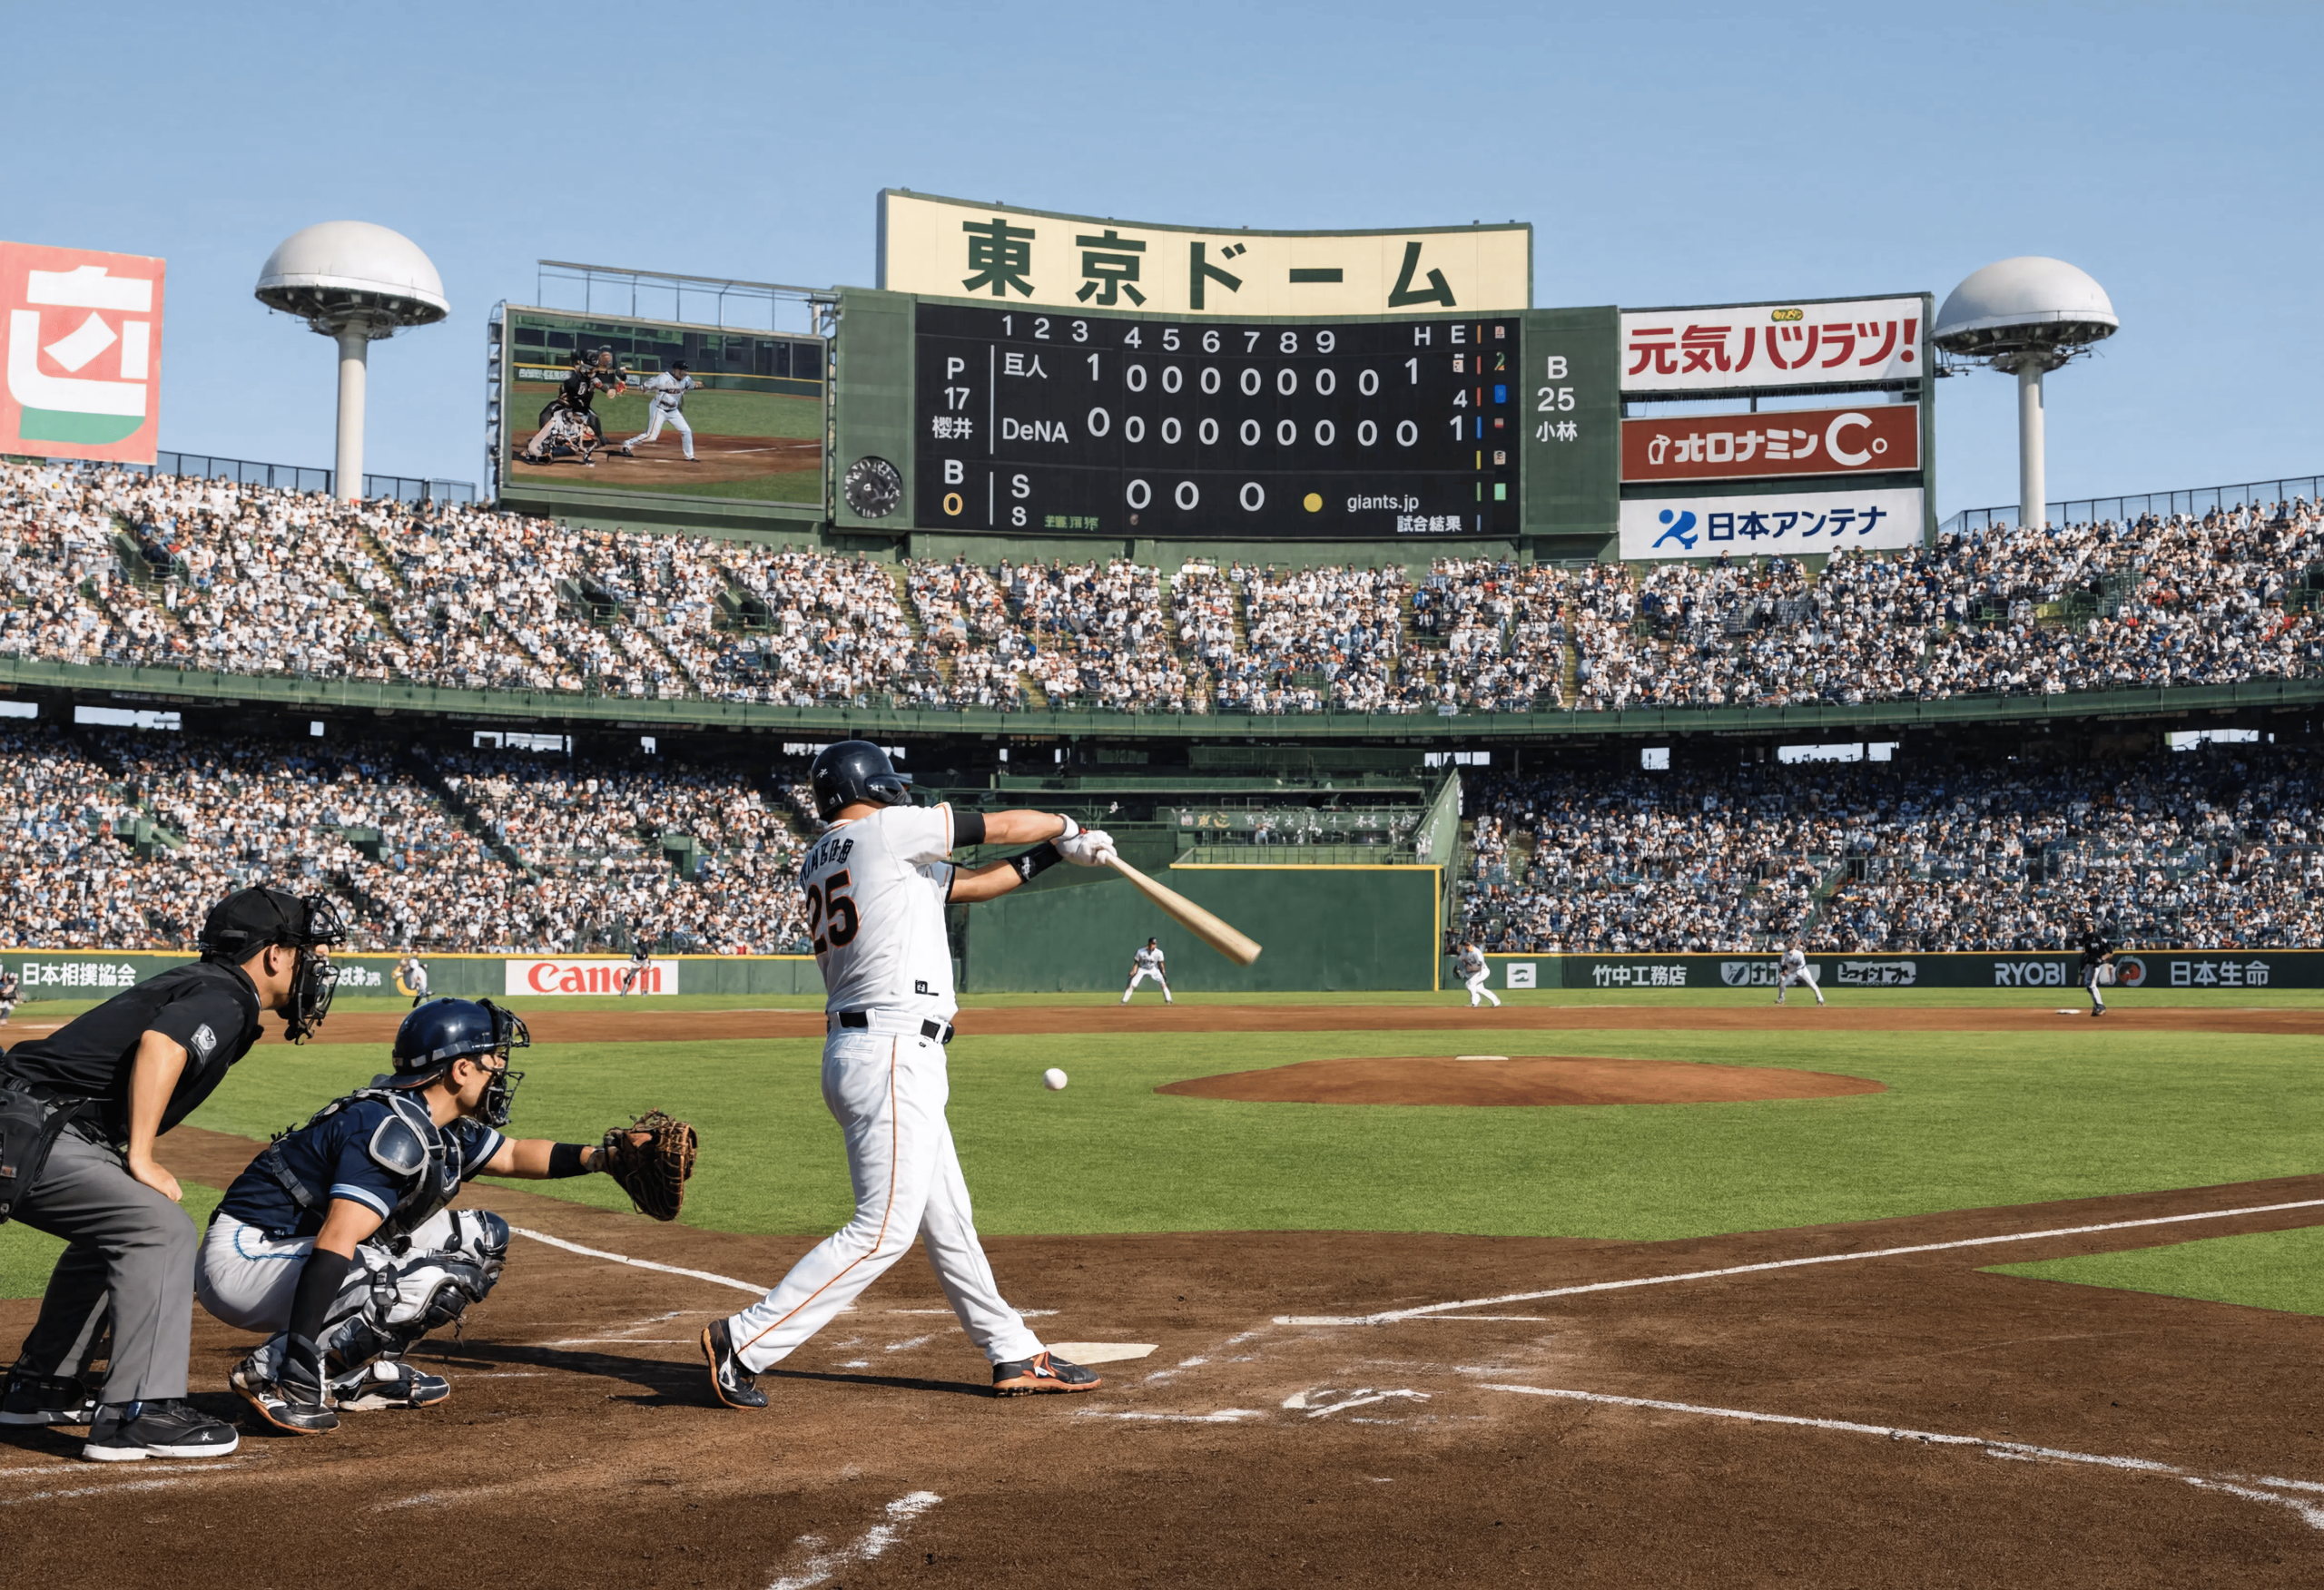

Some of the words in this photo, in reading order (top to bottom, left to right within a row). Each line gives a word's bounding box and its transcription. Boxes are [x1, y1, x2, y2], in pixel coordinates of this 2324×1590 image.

[962, 219, 1457, 309] 東京ドーム
[1002, 315, 1012, 336] 1
[1034, 318, 1050, 339] 2
[1071, 320, 1088, 342] 3
[1124, 327, 1142, 348] 4
[1162, 329, 1180, 351] 5
[1202, 330, 1221, 353] 6
[1244, 331, 1260, 353] 7
[1279, 331, 1298, 353] 8
[1315, 330, 1335, 353] 9
[1414, 327, 1431, 346] H
[1451, 325, 1466, 344] E
[947, 357, 965, 380] P
[1003, 352, 1049, 379] 巨人
[1087, 353, 1099, 381] 1
[1126, 364, 1147, 392] 0
[1161, 366, 1183, 394] 0
[1200, 367, 1221, 395] 0
[1240, 368, 1262, 396] 0
[1276, 368, 1297, 396] 0
[1316, 368, 1336, 396] 0
[1358, 368, 1379, 396] 0
[1404, 358, 1418, 385] 1
[1547, 355, 1569, 379] B
[944, 387, 970, 410] 17
[1452, 389, 1468, 408] 4
[1537, 387, 1575, 411] 25
[1002, 417, 1069, 444] DeNA
[1088, 407, 1110, 437] 0
[1125, 416, 1146, 443] 0
[1161, 417, 1182, 444] 0
[1198, 418, 1219, 445] 0
[1239, 419, 1261, 446] 0
[1276, 419, 1297, 447] 0
[1315, 419, 1335, 447] 0
[1357, 420, 1378, 447] 0
[1396, 420, 1418, 447] 0
[1449, 415, 1462, 441] 1
[1535, 420, 1578, 443] 小林
[944, 458, 964, 485] B
[943, 493, 963, 515] 0
[1011, 474, 1030, 499] S
[1126, 479, 1152, 509] 0
[1175, 481, 1199, 510] 0
[1239, 482, 1265, 512] 0
[1346, 495, 1420, 513] giants.jp
[1011, 506, 1027, 526] S
[1396, 515, 1462, 533] 試合結果
[1708, 505, 1887, 541] 日本アンテナ
[806, 869, 860, 956] 25
[527, 963, 661, 993] Canon
[1591, 964, 1688, 986] 竹中工務店
[1994, 962, 2066, 986] RYOBI
[2170, 960, 2270, 986] 日本生命
